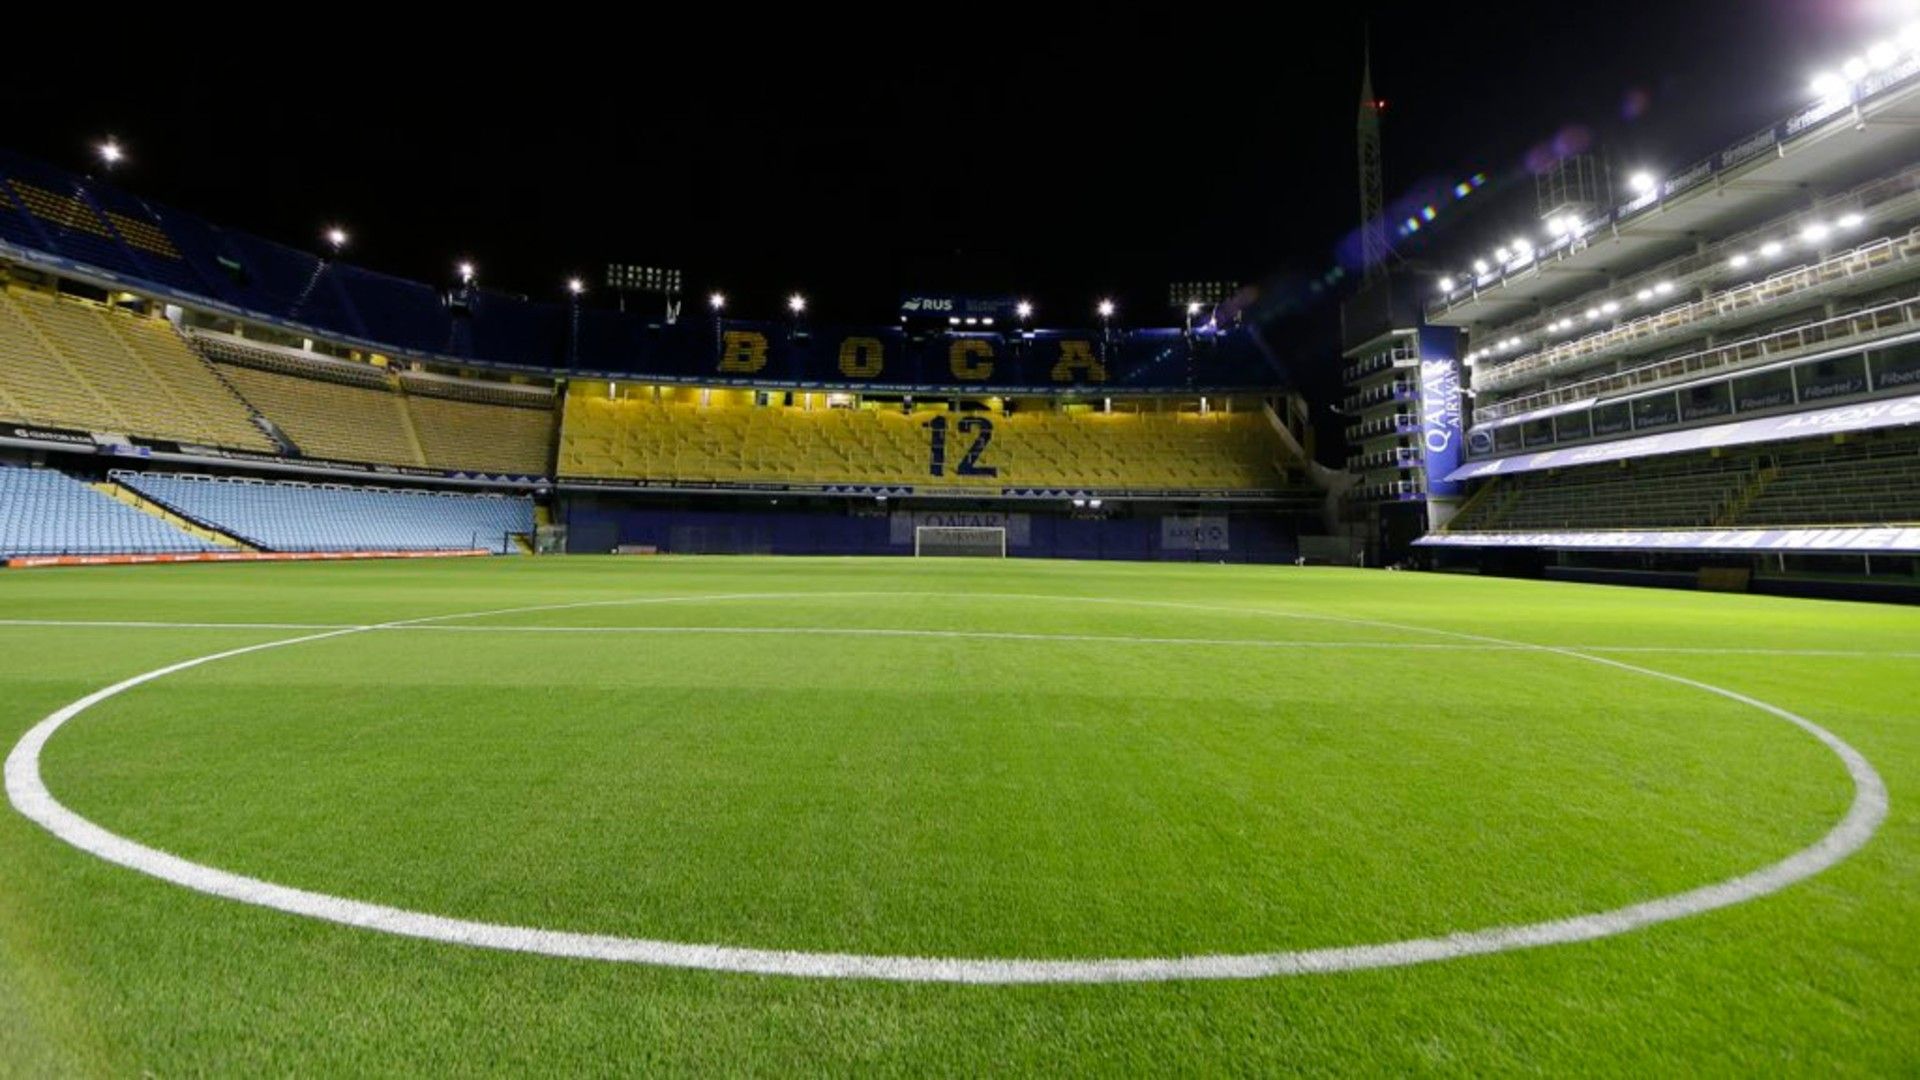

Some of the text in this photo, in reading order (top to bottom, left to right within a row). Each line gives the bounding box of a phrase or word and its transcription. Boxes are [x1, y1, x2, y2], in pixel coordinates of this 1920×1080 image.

[922, 299, 953, 311] RUS
[717, 330, 1109, 382] BOCA
[1421, 360, 1452, 452] QATAR
[1776, 404, 1890, 431] AXION
[922, 415, 997, 477] 12
[925, 513, 998, 529] QATAR
